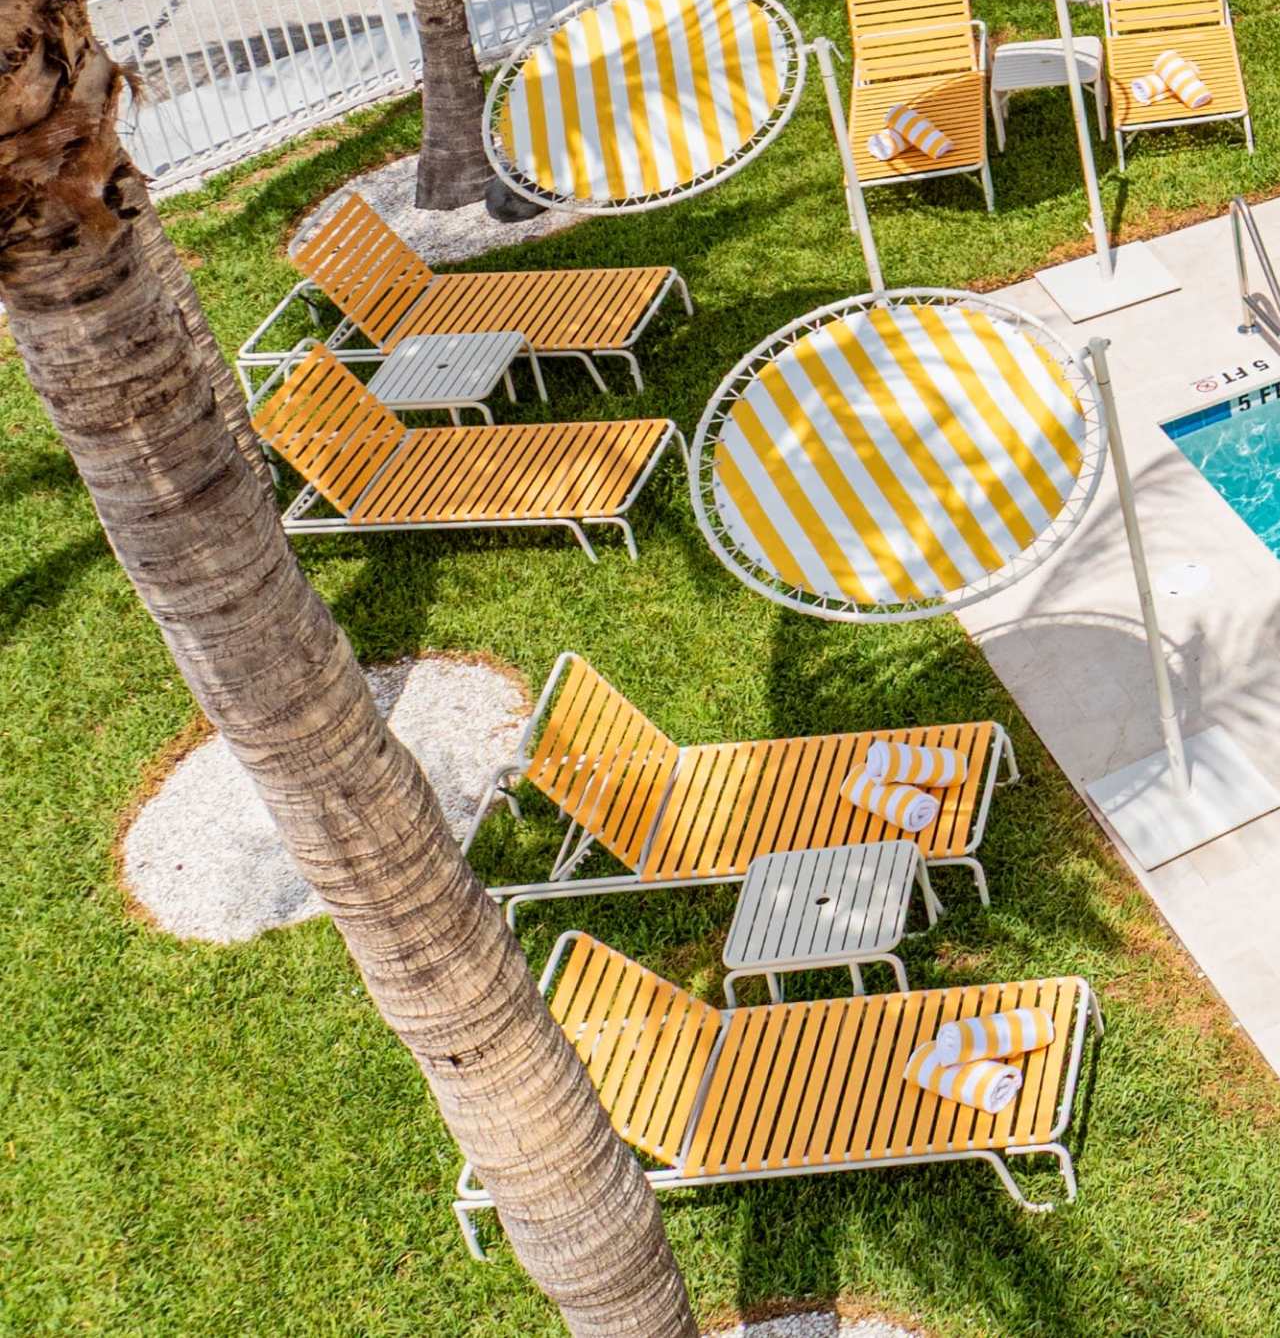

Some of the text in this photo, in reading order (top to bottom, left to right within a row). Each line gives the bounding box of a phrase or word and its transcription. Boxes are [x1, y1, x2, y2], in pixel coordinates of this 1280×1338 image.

[1252, 359, 1269, 371] 5
[1222, 367, 1248, 384] FT
[1238, 394, 1251, 412] 5
